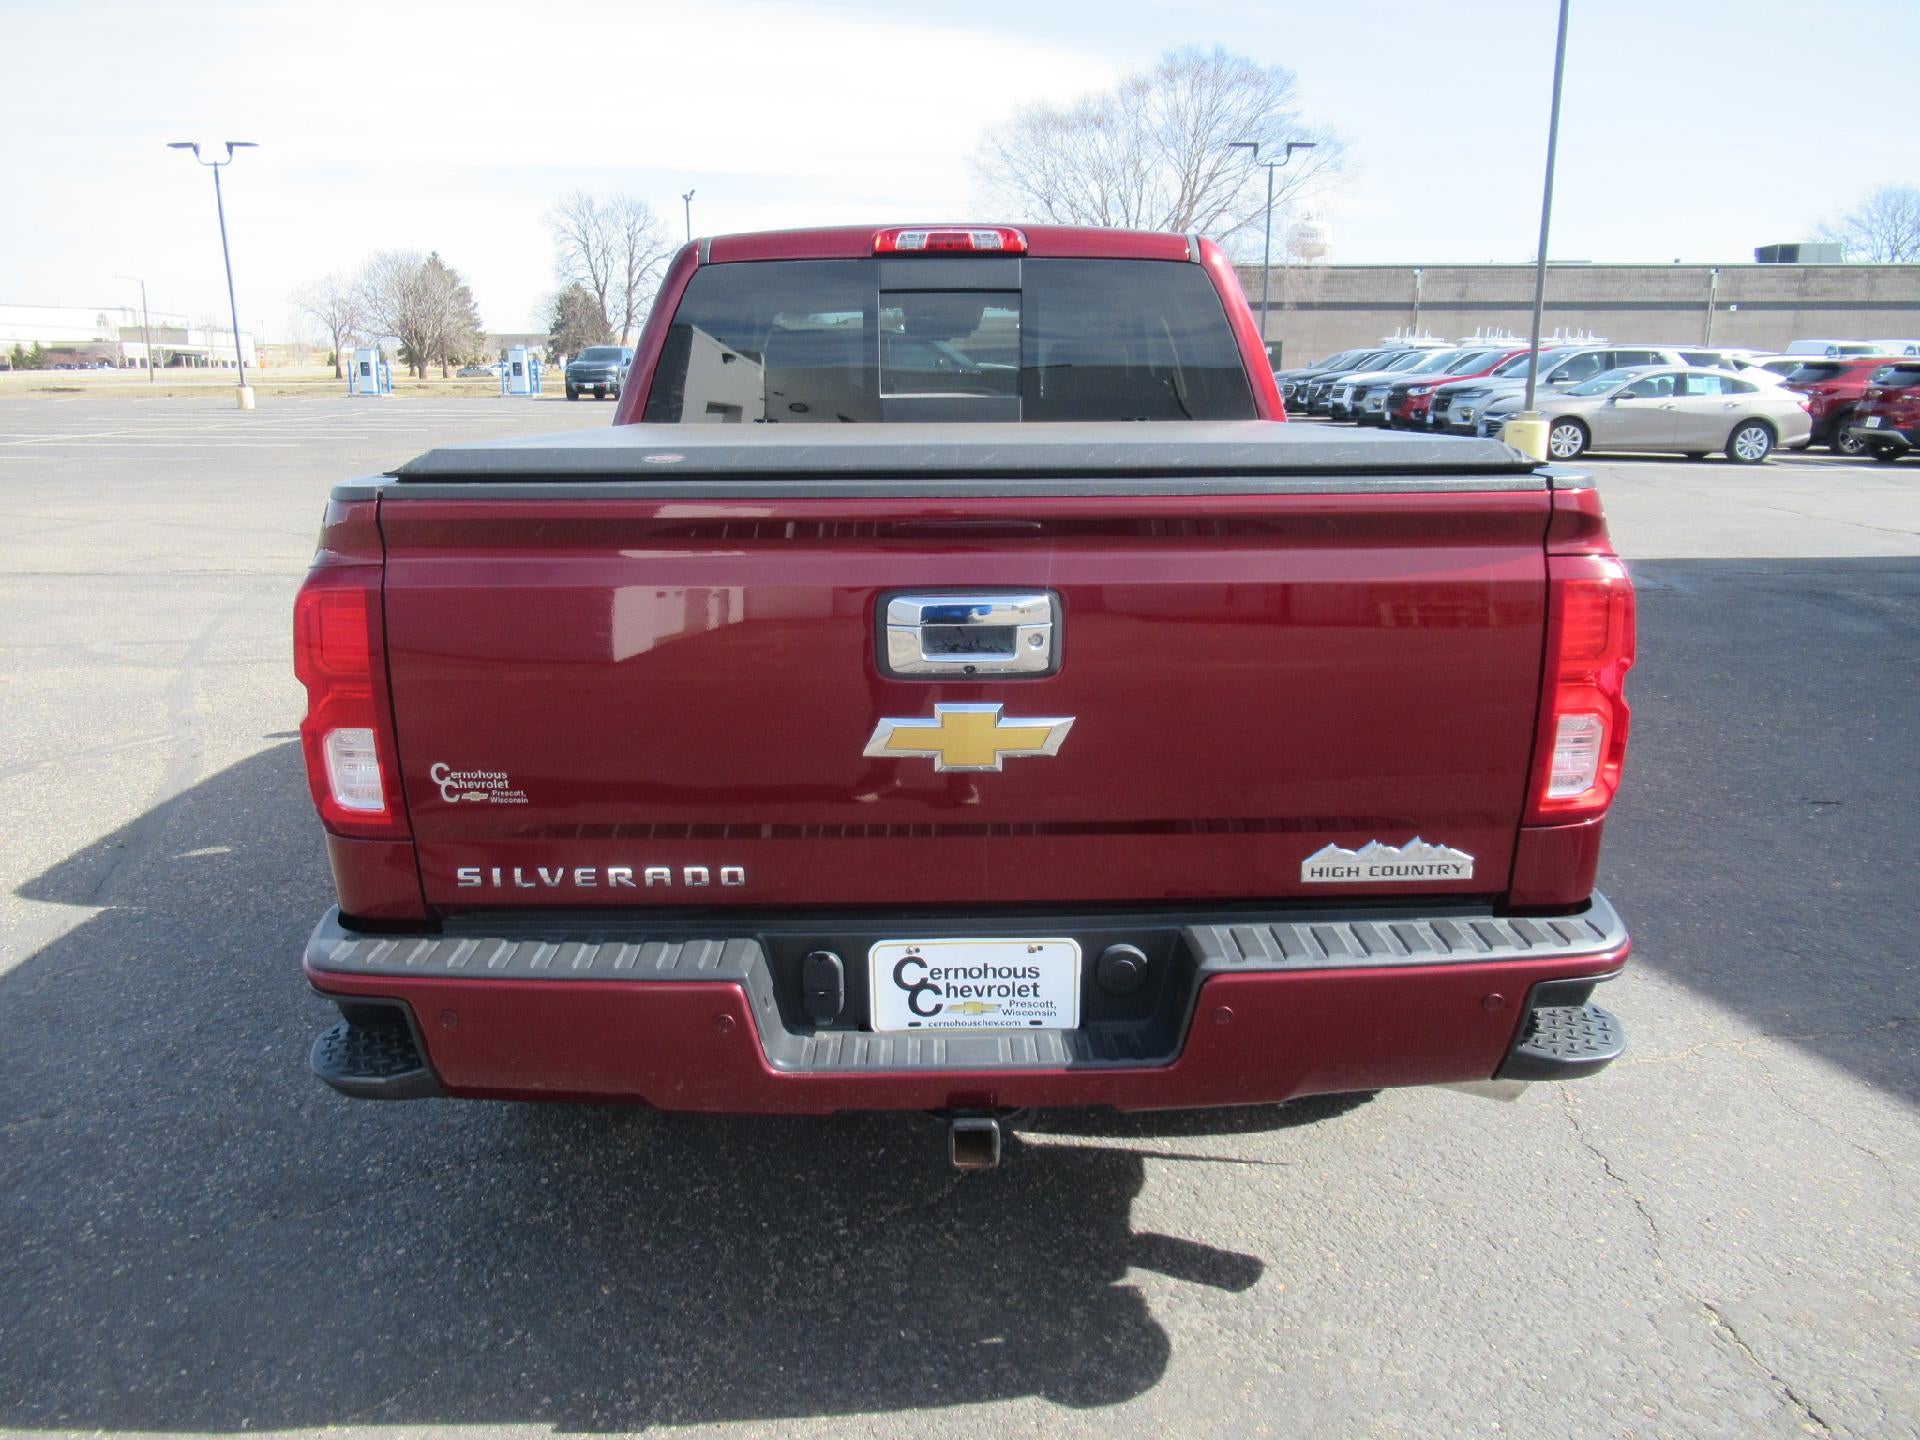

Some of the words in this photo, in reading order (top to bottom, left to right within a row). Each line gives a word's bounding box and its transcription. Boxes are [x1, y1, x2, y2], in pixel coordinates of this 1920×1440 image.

[430, 762, 508, 785] Cernohous
[441, 779, 510, 803] Chevrolet
[457, 867, 746, 888] SILVERADO
[1310, 866, 1360, 878] HIGH
[1369, 864, 1465, 877] COUNTRY
[893, 956, 1040, 991] Cernohous
[908, 981, 1041, 1017] Chevrolet
[1009, 999, 1057, 1010] Prescott,
[928, 1018, 1021, 1028] cernohouschev.com
[1002, 1009, 1057, 1017] Wisconsin
